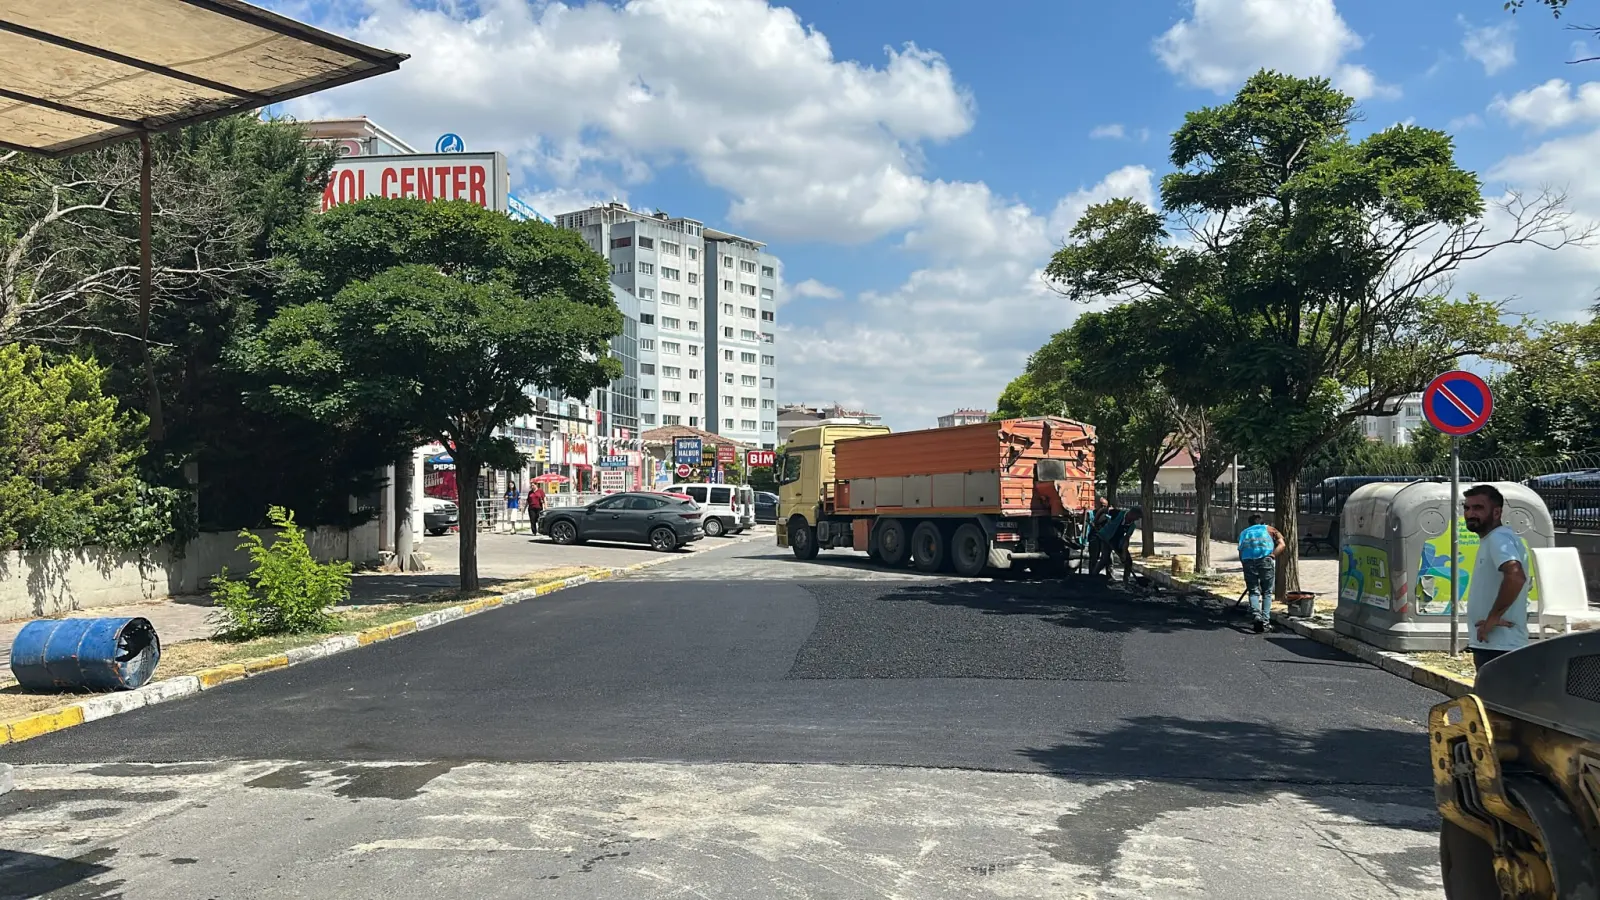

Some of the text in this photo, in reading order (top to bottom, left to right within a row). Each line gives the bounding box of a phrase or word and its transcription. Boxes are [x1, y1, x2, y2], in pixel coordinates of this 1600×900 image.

[306, 165, 486, 212] KOL CENTER
[678, 441, 699, 449] BÜYÜK
[750, 452, 774, 464] BİM
[433, 463, 456, 471] PEPSI
